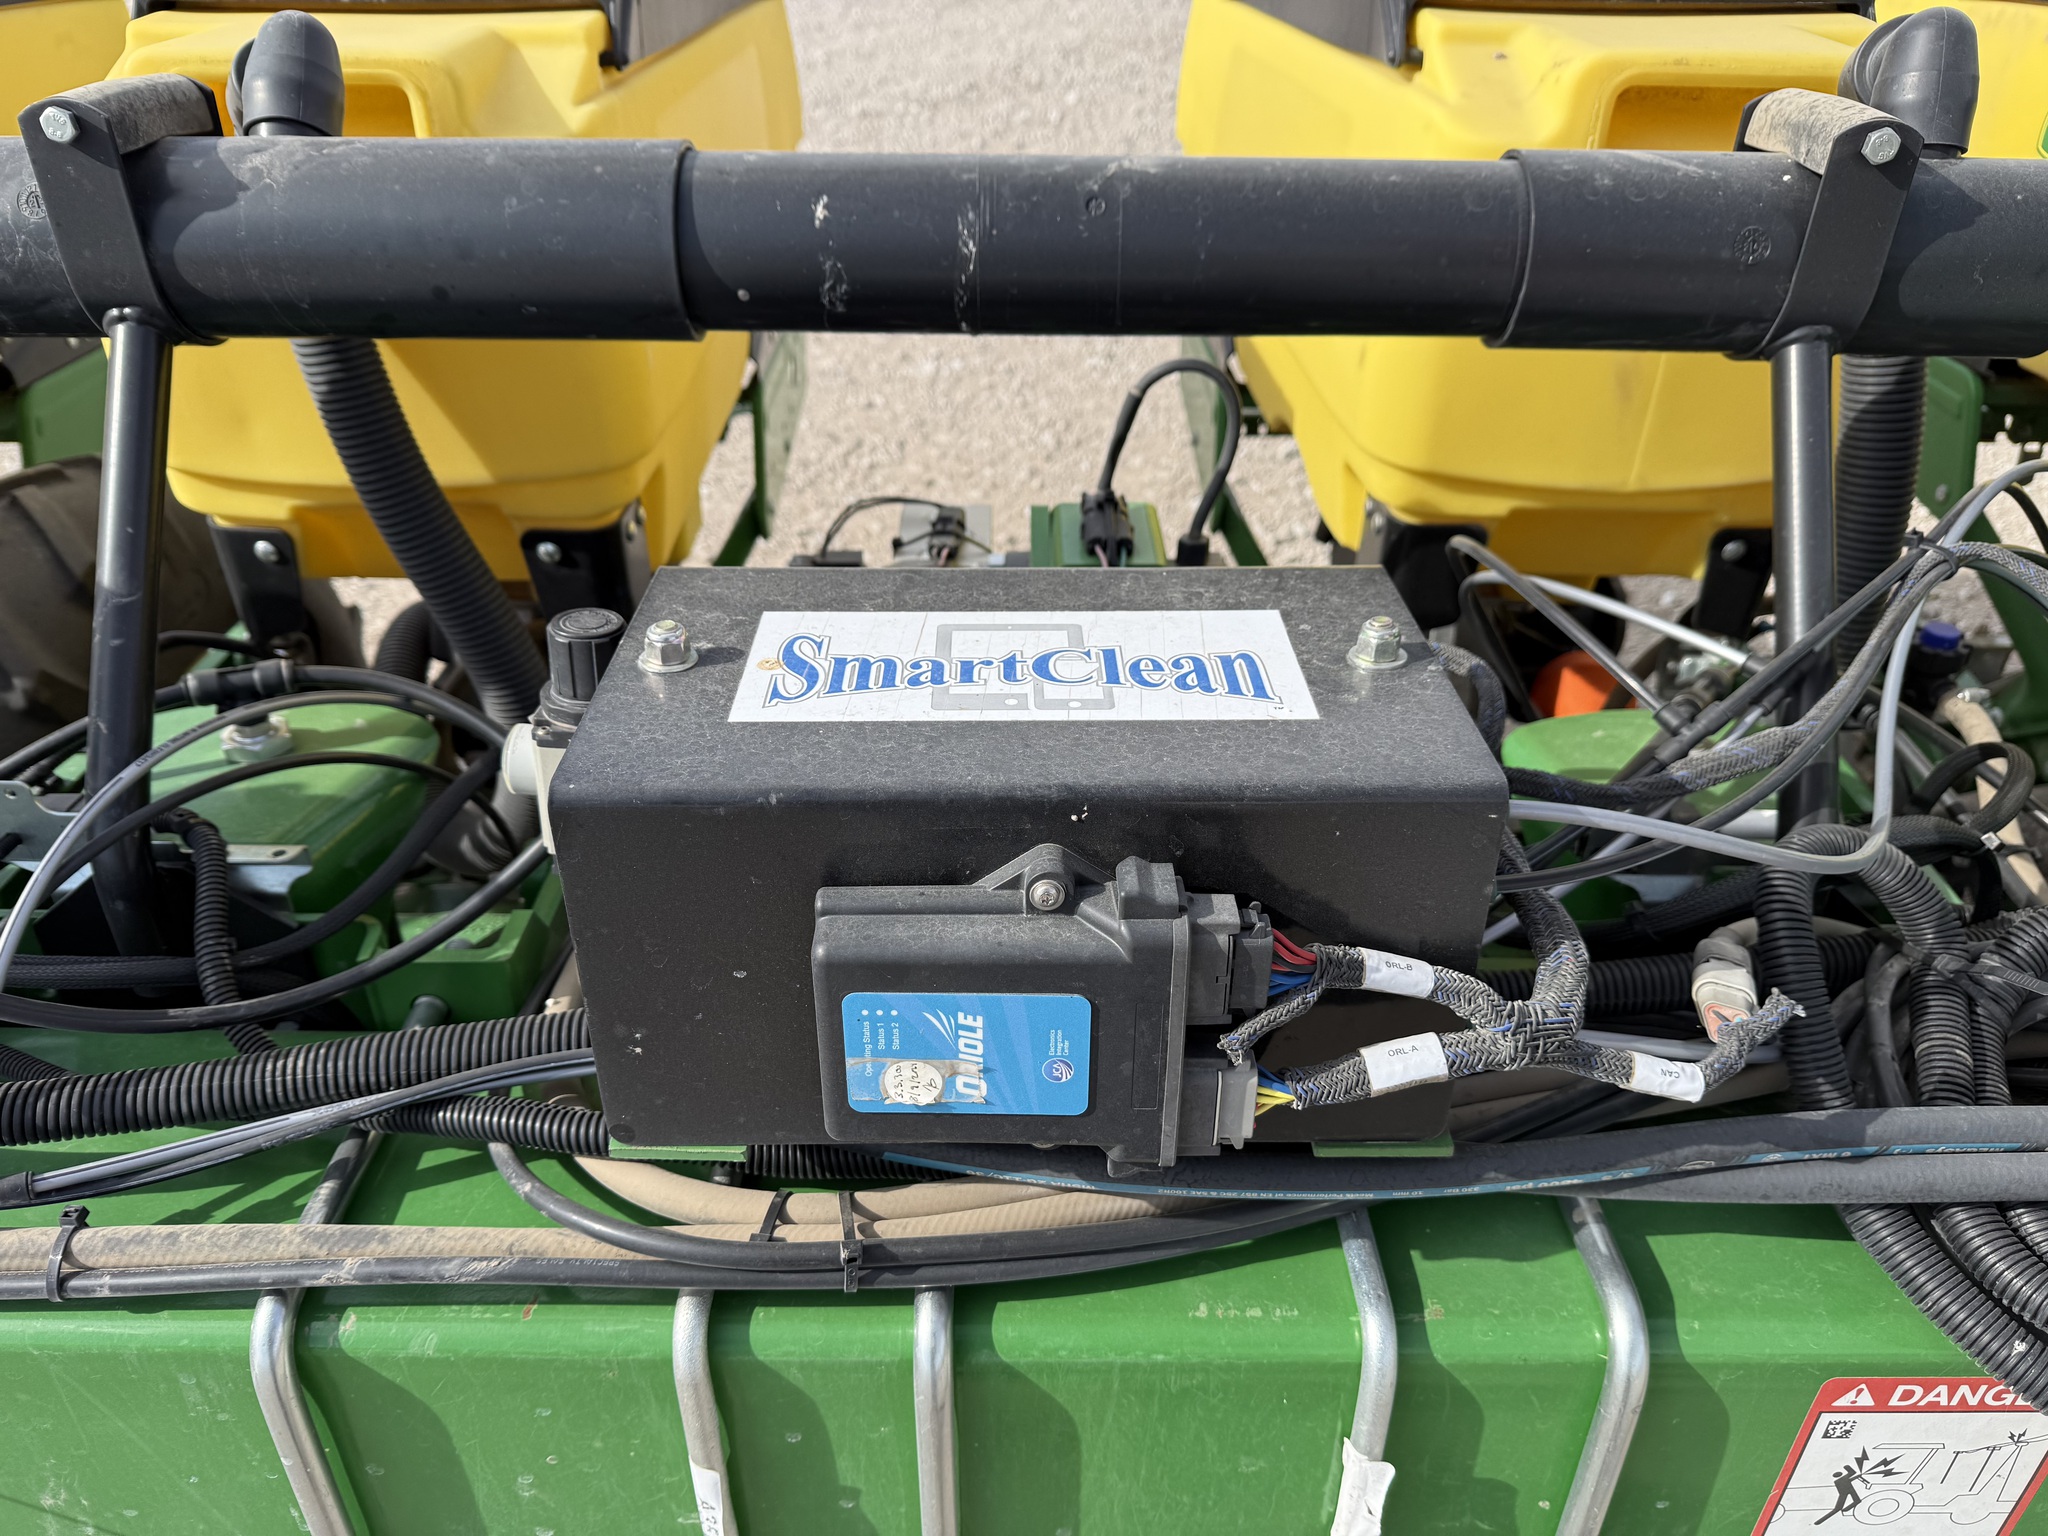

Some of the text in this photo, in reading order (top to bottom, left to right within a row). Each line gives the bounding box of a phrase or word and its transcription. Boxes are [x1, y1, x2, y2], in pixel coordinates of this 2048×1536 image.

[763, 632, 1285, 708] SmartClean
[862, 1021, 874, 1077] Opeting Status
[877, 1028, 886, 1050] Status
[892, 1028, 900, 1050] Status
[1055, 1029, 1063, 1056] Integration
[955, 1011, 988, 1097] OIOLE
[1388, 1045, 1419, 1057] ORL-A
[1052, 1063, 1062, 1078] JCA
[1660, 1068, 1680, 1079] CAN
[1888, 1384, 2033, 1407] DANG
